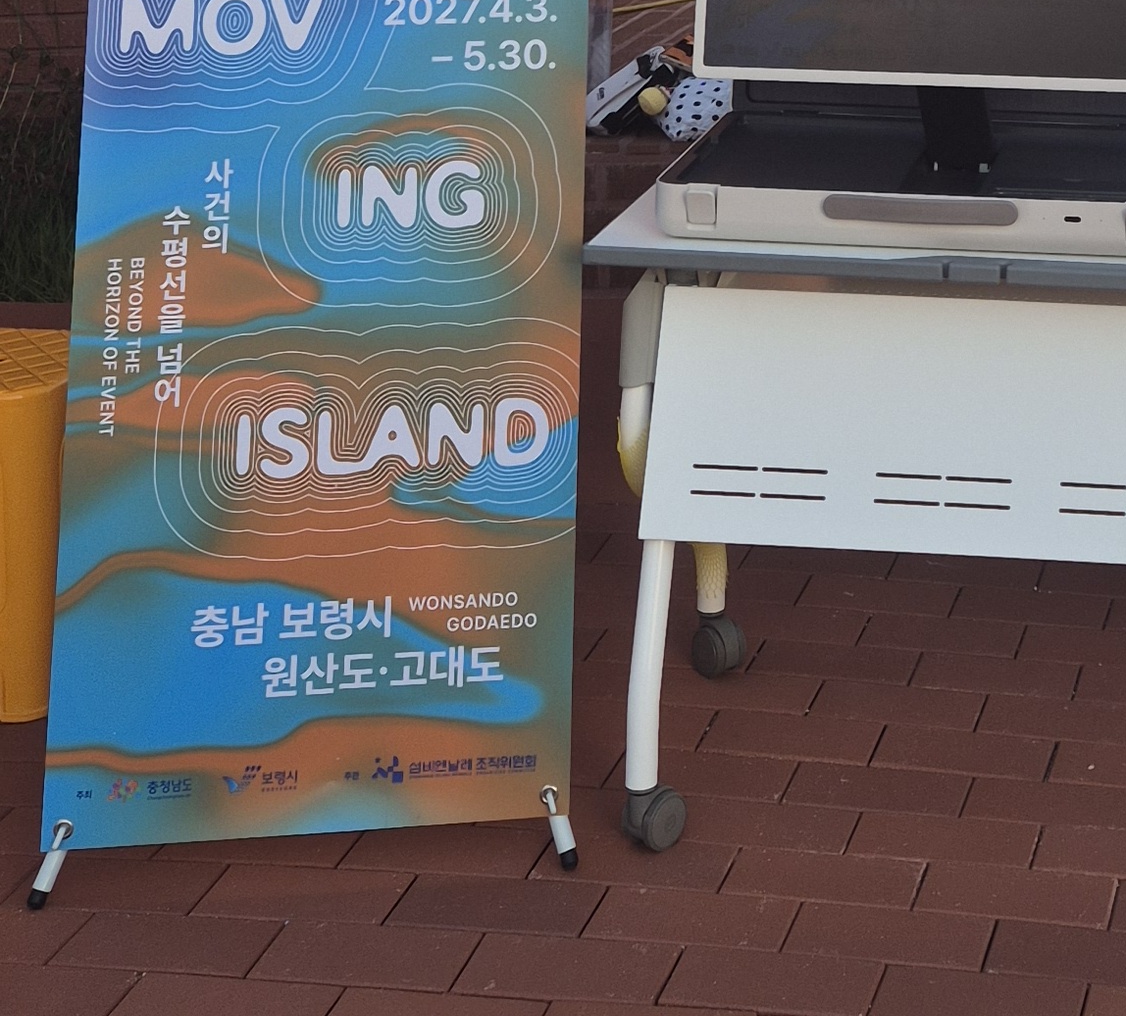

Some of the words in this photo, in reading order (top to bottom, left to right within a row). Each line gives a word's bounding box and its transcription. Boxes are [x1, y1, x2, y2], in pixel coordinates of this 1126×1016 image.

[463, 39, 557, 72] 5.30.
[202, 158, 234, 254] 사건의
[337, 160, 485, 228] ING
[127, 257, 146, 333] BEYOND
[158, 206, 191, 334] 수평선을
[104, 259, 123, 342] HORIZON
[102, 347, 118, 371] OF
[125, 338, 141, 374] THE
[154, 343, 183, 408] 넘어
[99, 376, 117, 437] EVENT
[236, 397, 549, 479] ISLAND
[190, 602, 269, 649] 충남
[279, 596, 393, 640] 보령시
[408, 591, 518, 613] WONSANDO
[446, 613, 537, 632] GODAEDO
[261, 645, 504, 699] 원산도·고대도
[147, 778, 192, 795] 충청남도
[262, 770, 298, 785] 보령시
[409, 758, 473, 774] 섬비엔날레
[476, 754, 537, 770] 조직위원회
